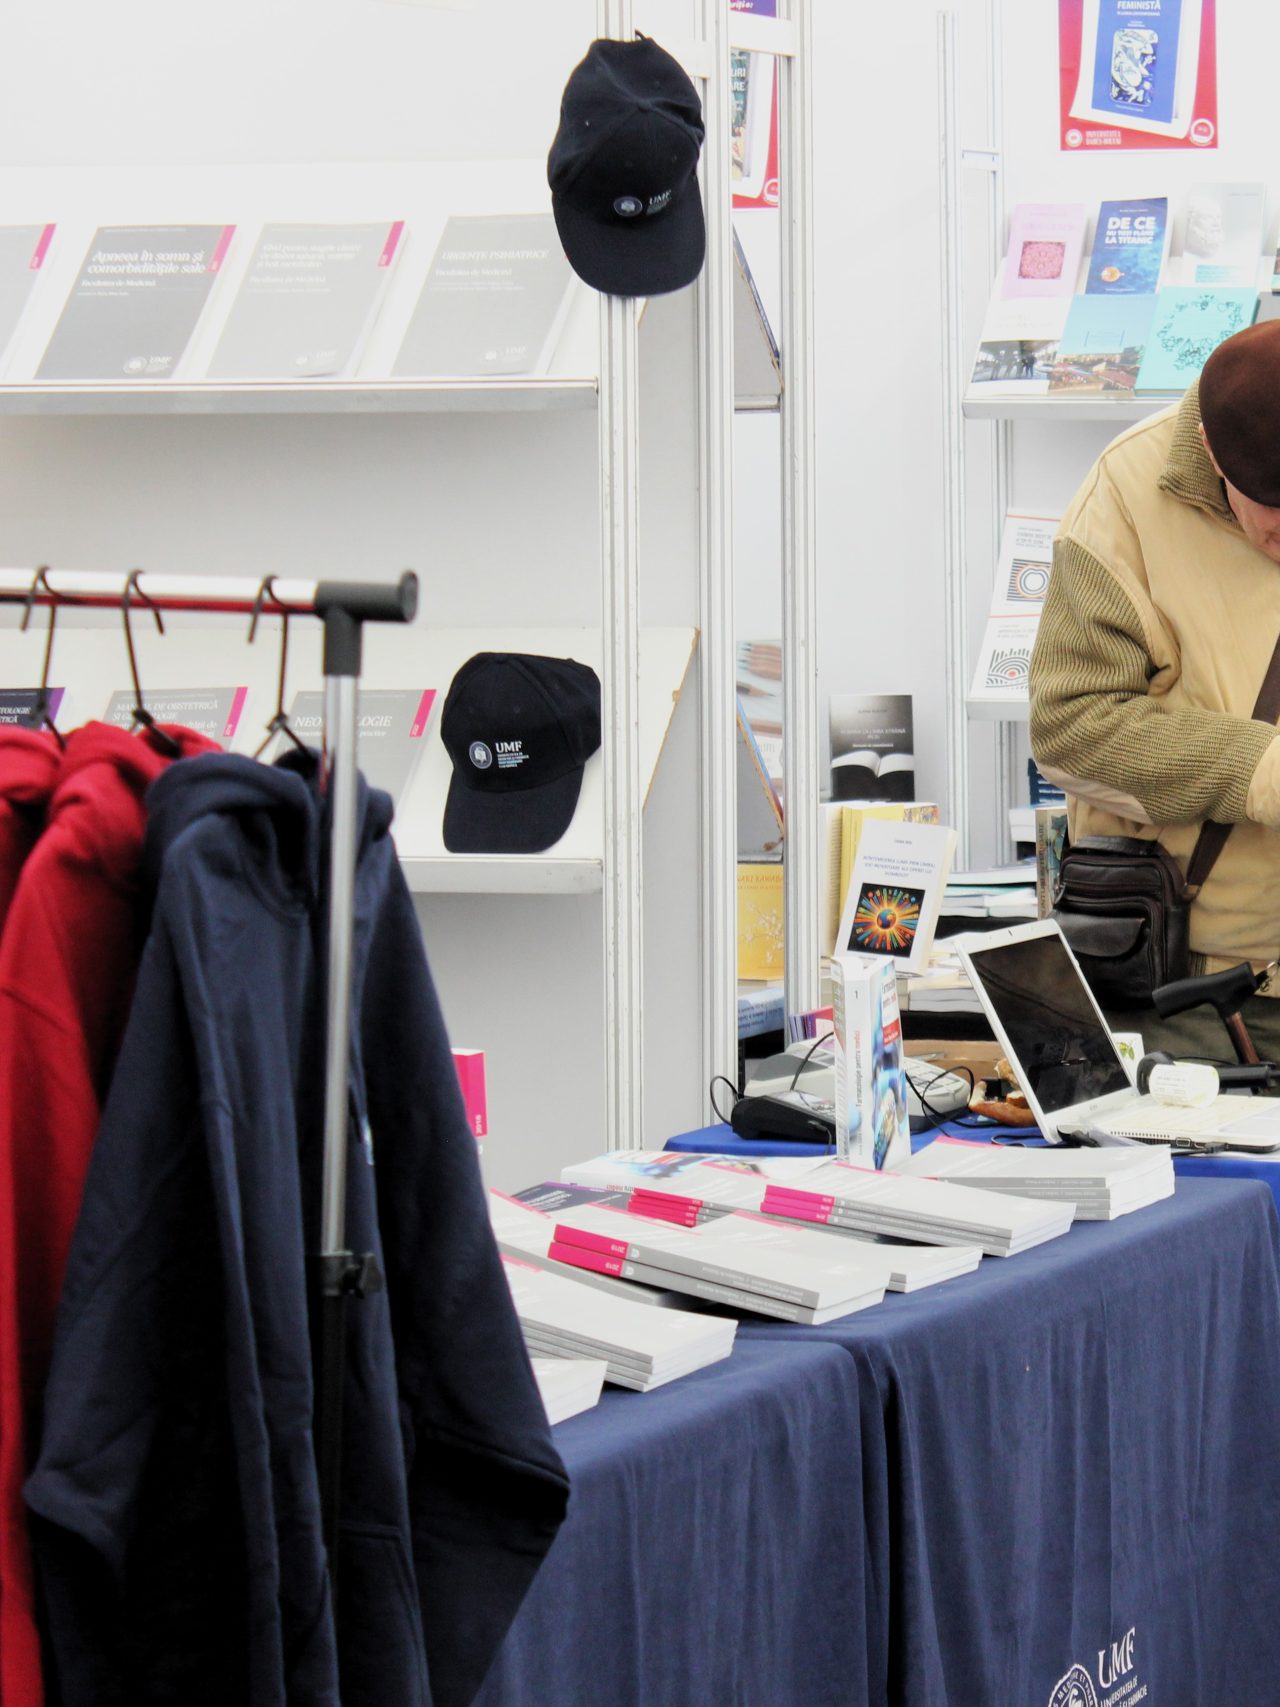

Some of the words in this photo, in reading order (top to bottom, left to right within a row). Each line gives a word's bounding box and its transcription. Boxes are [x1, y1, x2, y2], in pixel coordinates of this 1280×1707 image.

[1107, 217, 1131, 230] DE
[1134, 216, 1156, 230] CE
[1105, 236, 1117, 244] LA
[1118, 236, 1153, 245] TITANIC
[92, 250, 139, 264] Apneea
[181, 263, 206, 274] sale
[495, 741, 523, 753] UMF
[1098, 1626, 1136, 1689] UMF
